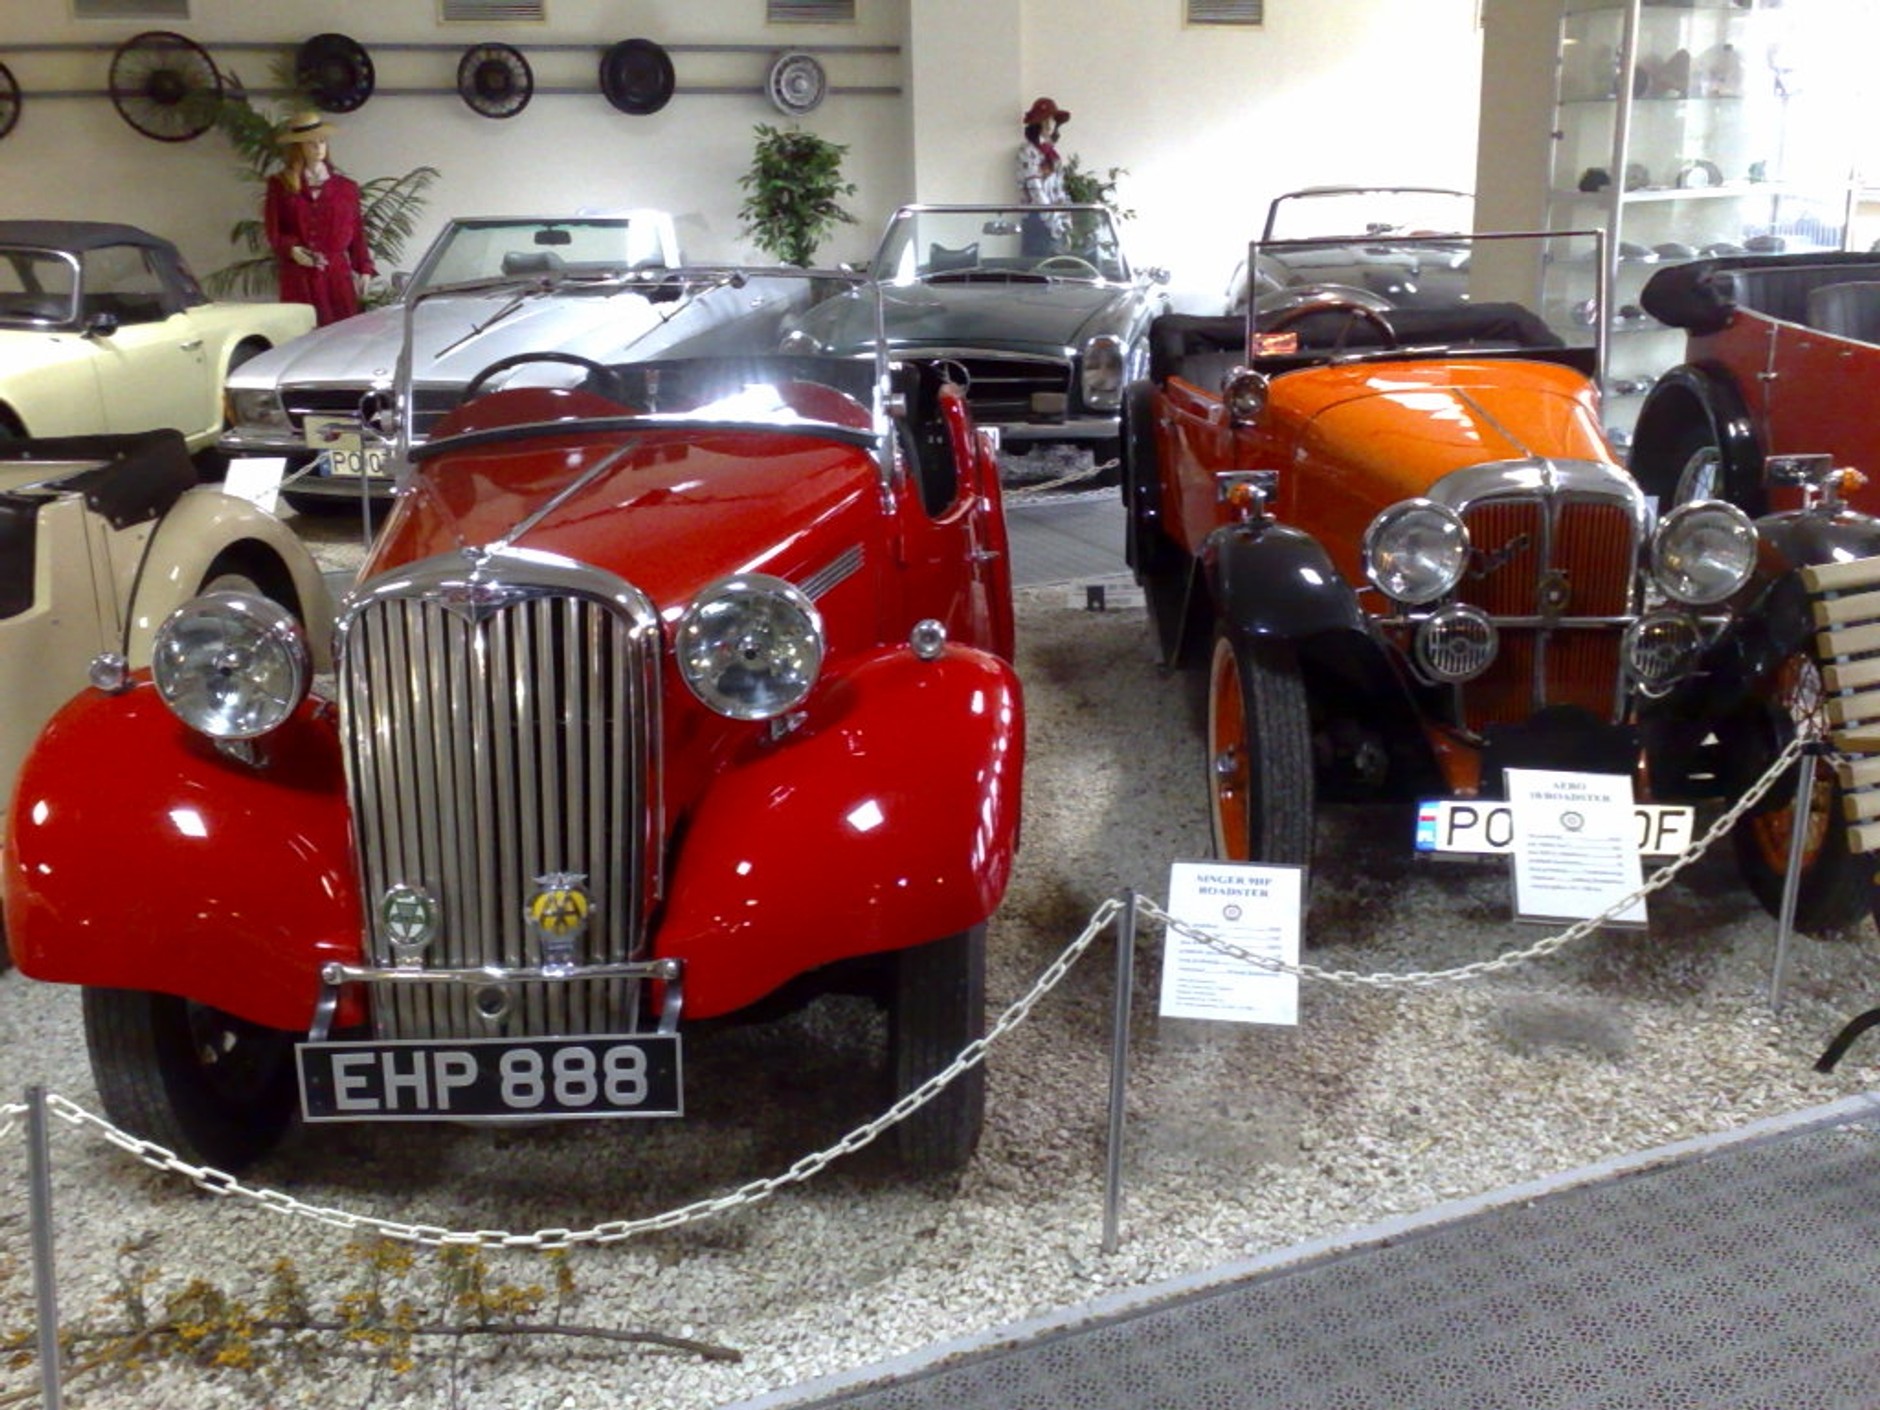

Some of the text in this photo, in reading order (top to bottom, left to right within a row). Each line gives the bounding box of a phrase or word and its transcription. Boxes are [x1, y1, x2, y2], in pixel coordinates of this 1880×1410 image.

[1197, 874, 1244, 884] SINGER
[1199, 886, 1268, 897] ROADSTER
[330, 1044, 648, 1110] EHP 888
